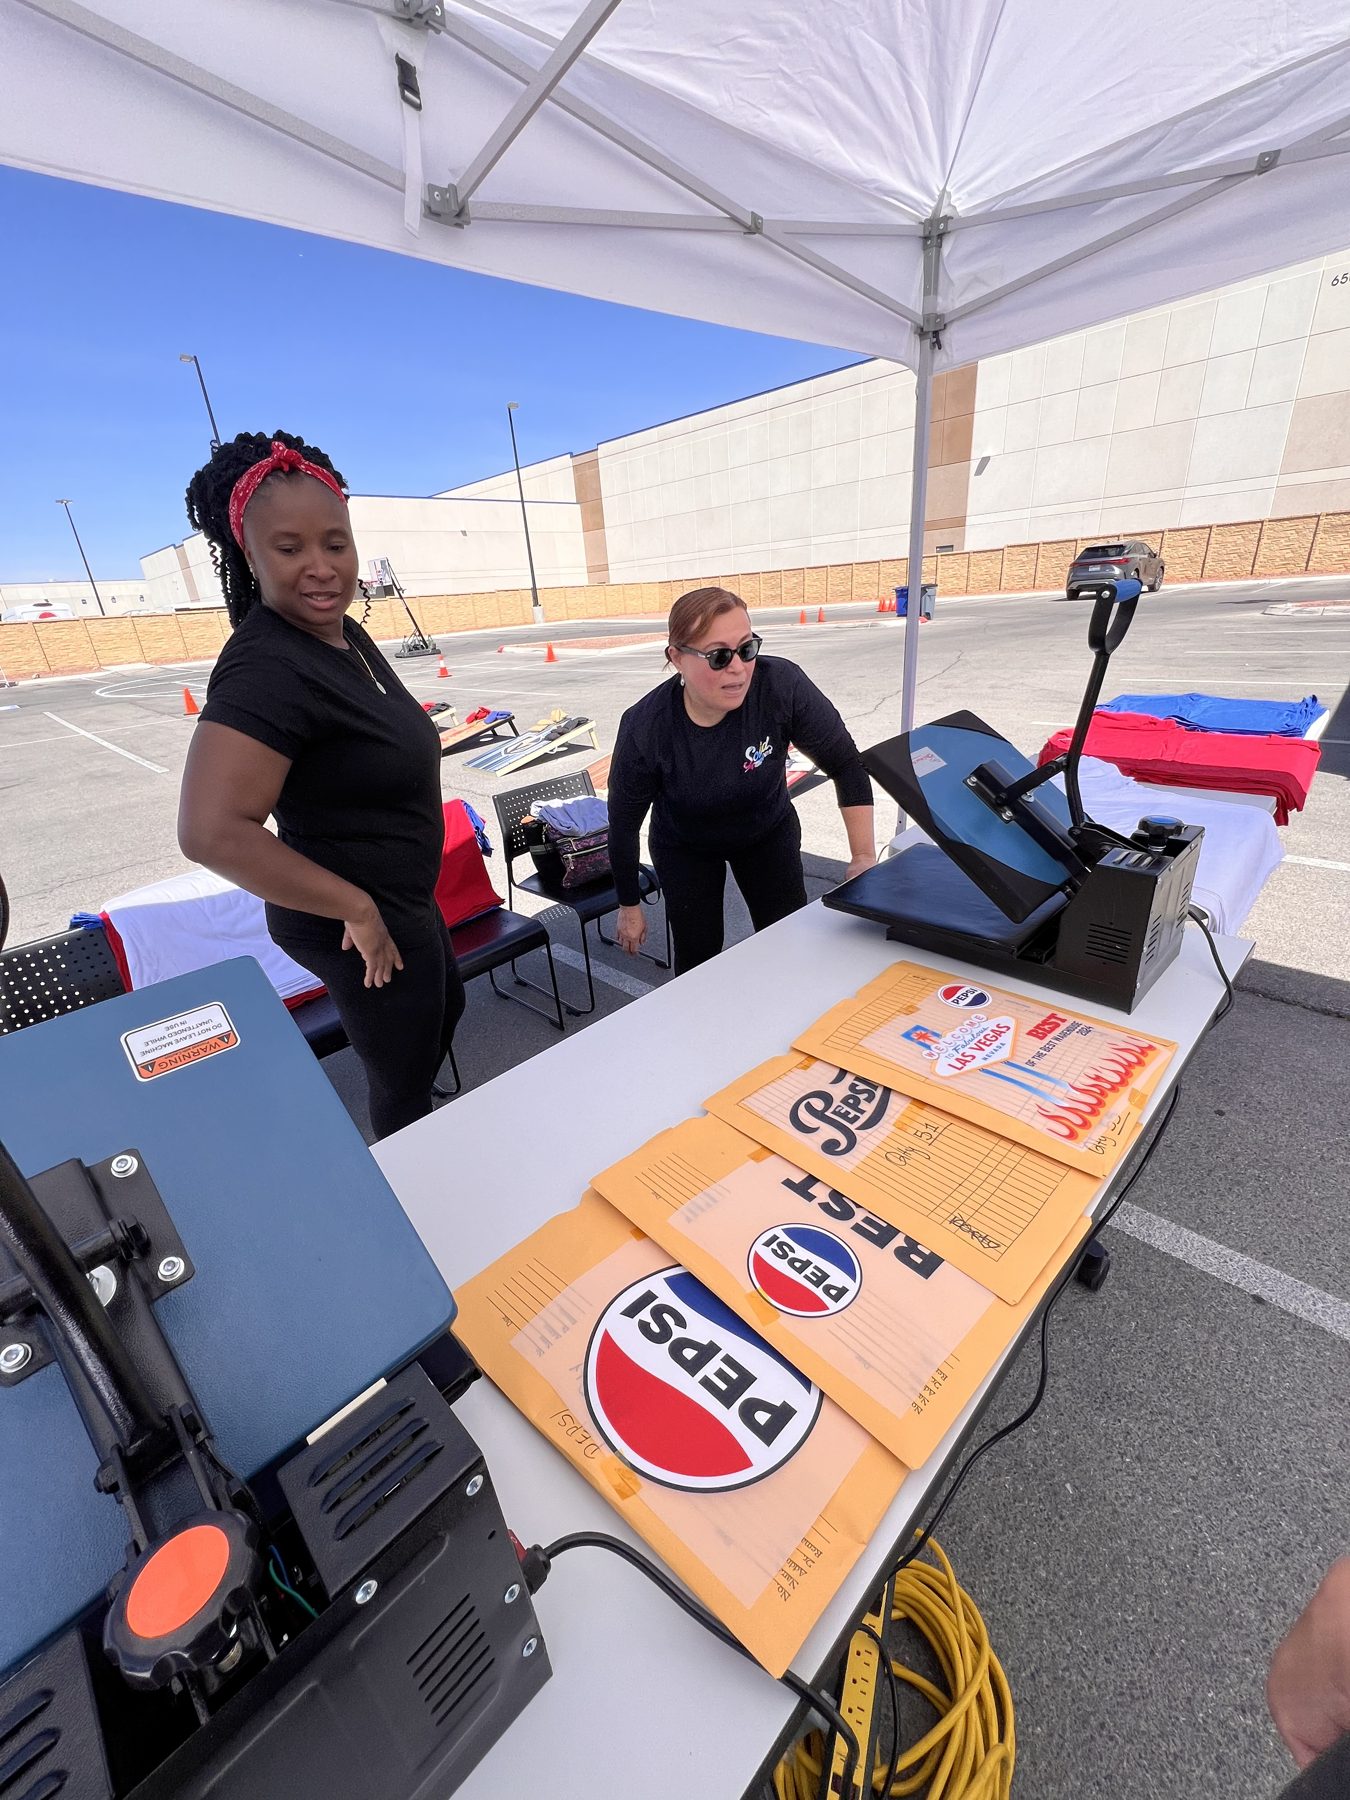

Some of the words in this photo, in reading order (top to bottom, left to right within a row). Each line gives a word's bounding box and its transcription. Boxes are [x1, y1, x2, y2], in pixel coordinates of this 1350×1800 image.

[1331, 272, 1350, 287] 65
[951, 987, 979, 1005] PEPSI
[164, 1023, 179, 1032] USE
[168, 1018, 213, 1039] UNATTENDED
[197, 1026, 212, 1036] NOT
[211, 1022, 223, 1031] DO
[1026, 1013, 1067, 1040] BEST
[1051, 1020, 1083, 1042] WAREHOUSE
[144, 1034, 167, 1047] WHILE
[175, 1032, 197, 1043] LEAVE
[923, 1014, 985, 1059] WELCOME
[952, 1026, 990, 1055] Fabulous
[140, 1039, 174, 1057] MACHINE
[158, 1041, 221, 1070] WARNING
[948, 1052, 976, 1071] LAS
[969, 1023, 1011, 1053] VEGAS
[981, 1042, 1007, 1061] NEVADA
[1031, 1050, 1048, 1061] THE
[1039, 1040, 1058, 1053] BEST
[1025, 1059, 1037, 1067] OF
[912, 1122, 941, 1142] 51
[761, 1233, 850, 1304] PEPSI
[619, 1289, 798, 1448] PEPSI
